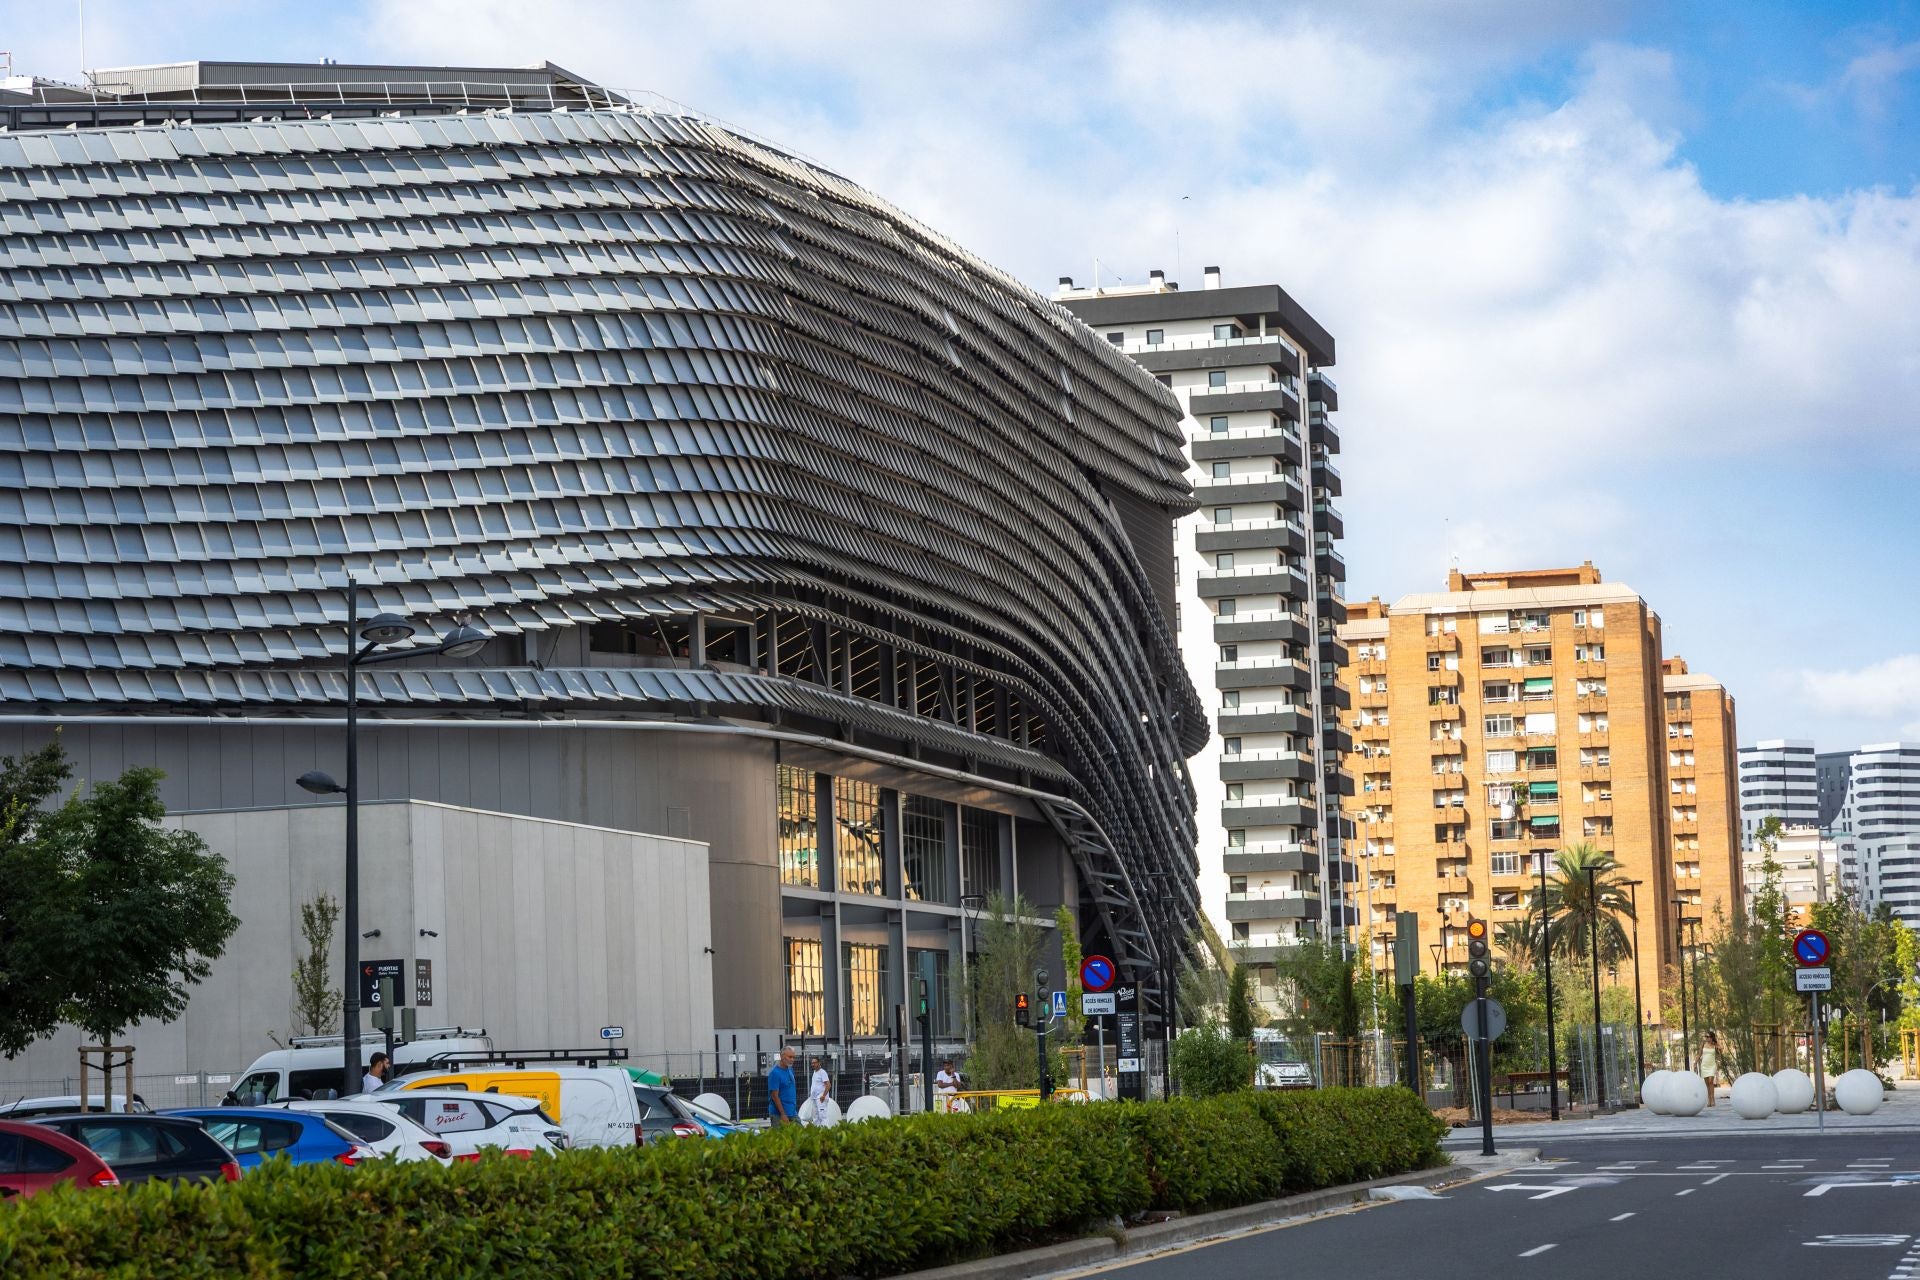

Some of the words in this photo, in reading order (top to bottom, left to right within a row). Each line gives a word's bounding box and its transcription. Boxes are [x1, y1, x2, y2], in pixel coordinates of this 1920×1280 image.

[372, 979, 379, 990] J
[371, 992, 381, 1002] G
[434, 1112, 468, 1126] Direct
